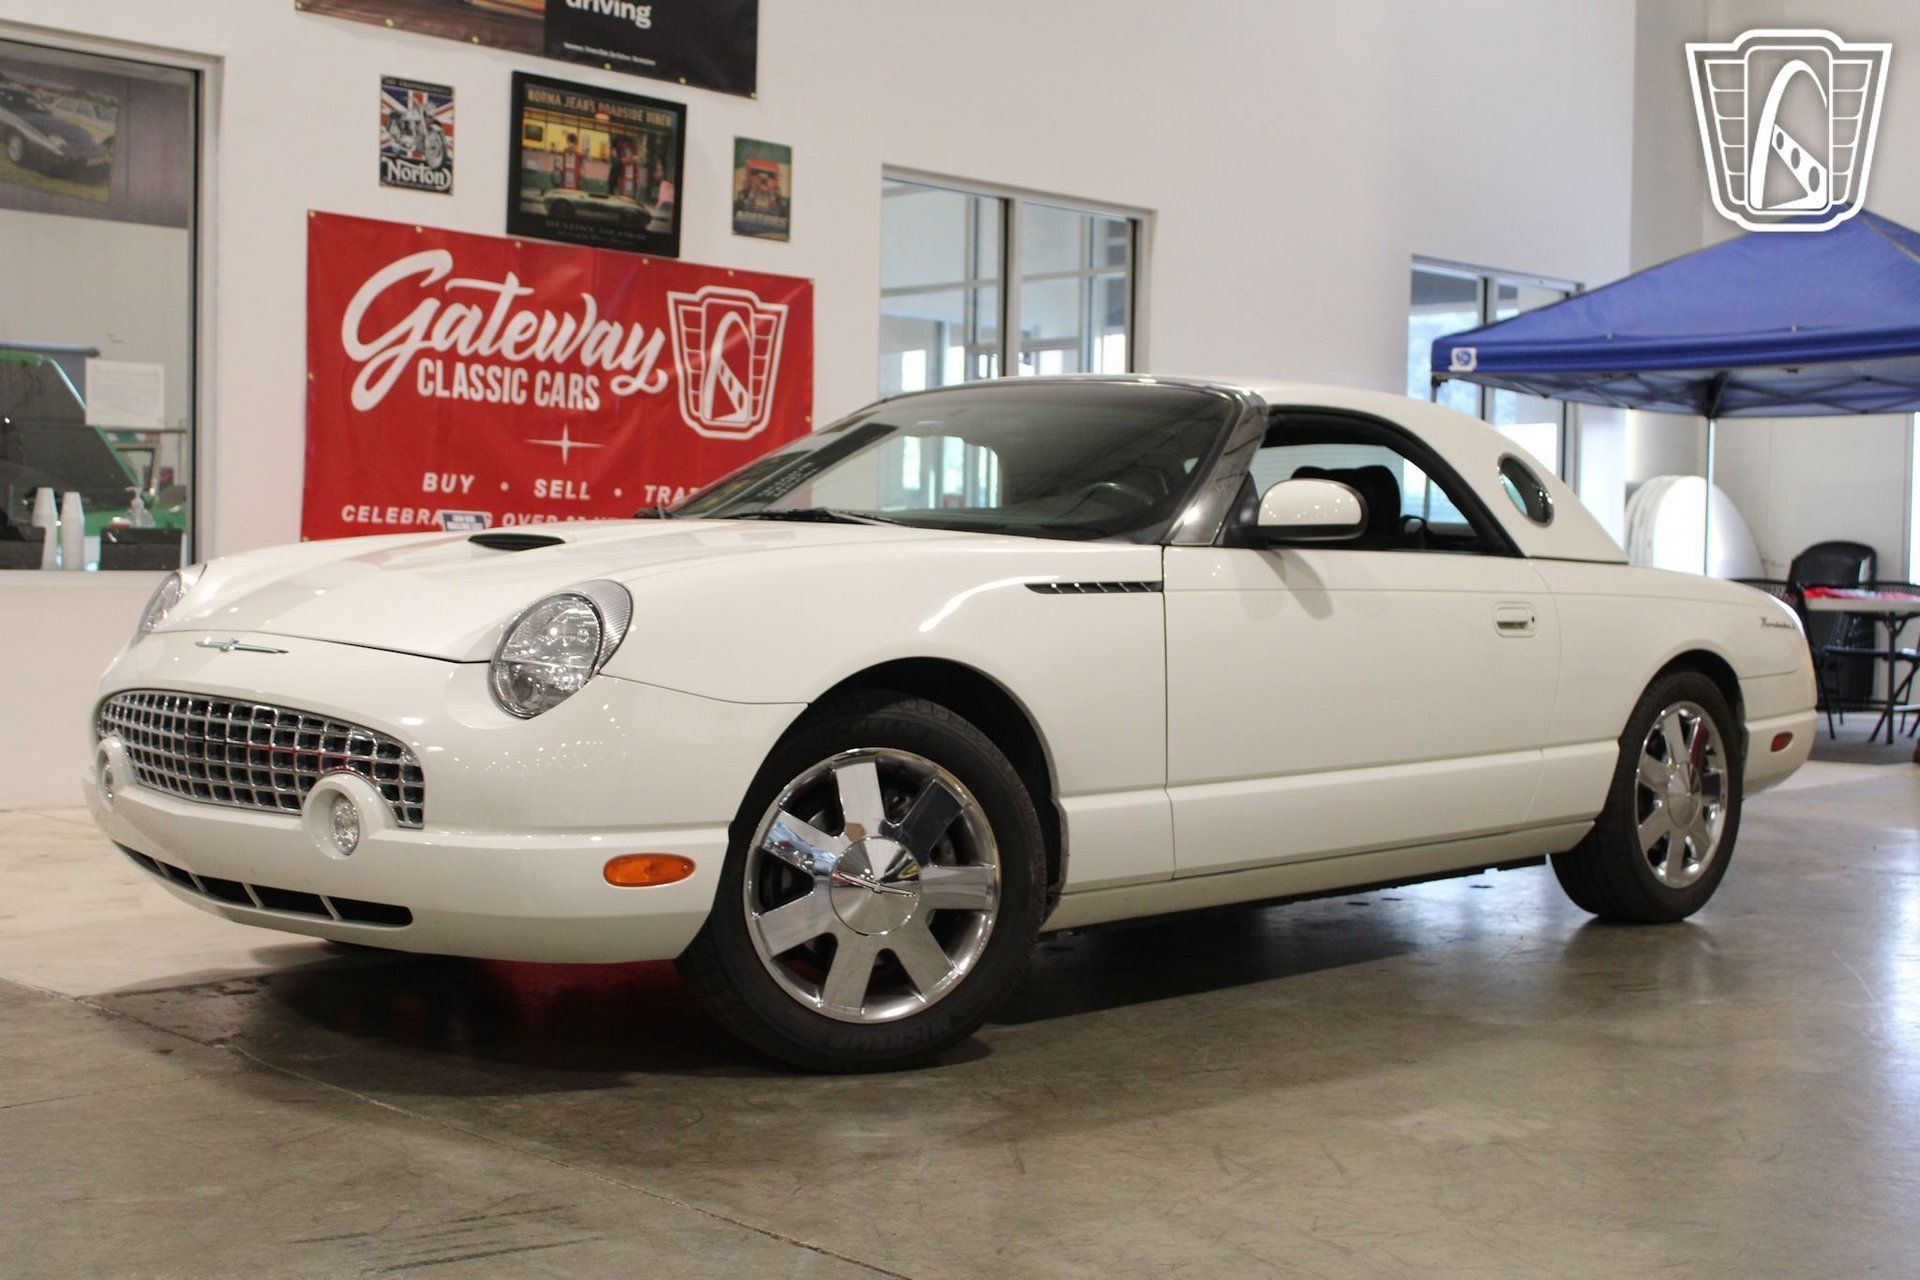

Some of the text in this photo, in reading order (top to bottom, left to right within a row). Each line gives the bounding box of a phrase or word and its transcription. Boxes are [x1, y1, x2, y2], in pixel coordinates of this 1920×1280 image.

[381, 156, 451, 191] Norton
[341, 249, 668, 412] Gateway
[417, 358, 600, 412] CLASSIC CARS
[422, 472, 475, 494] BUY
[534, 478, 590, 500] SELL
